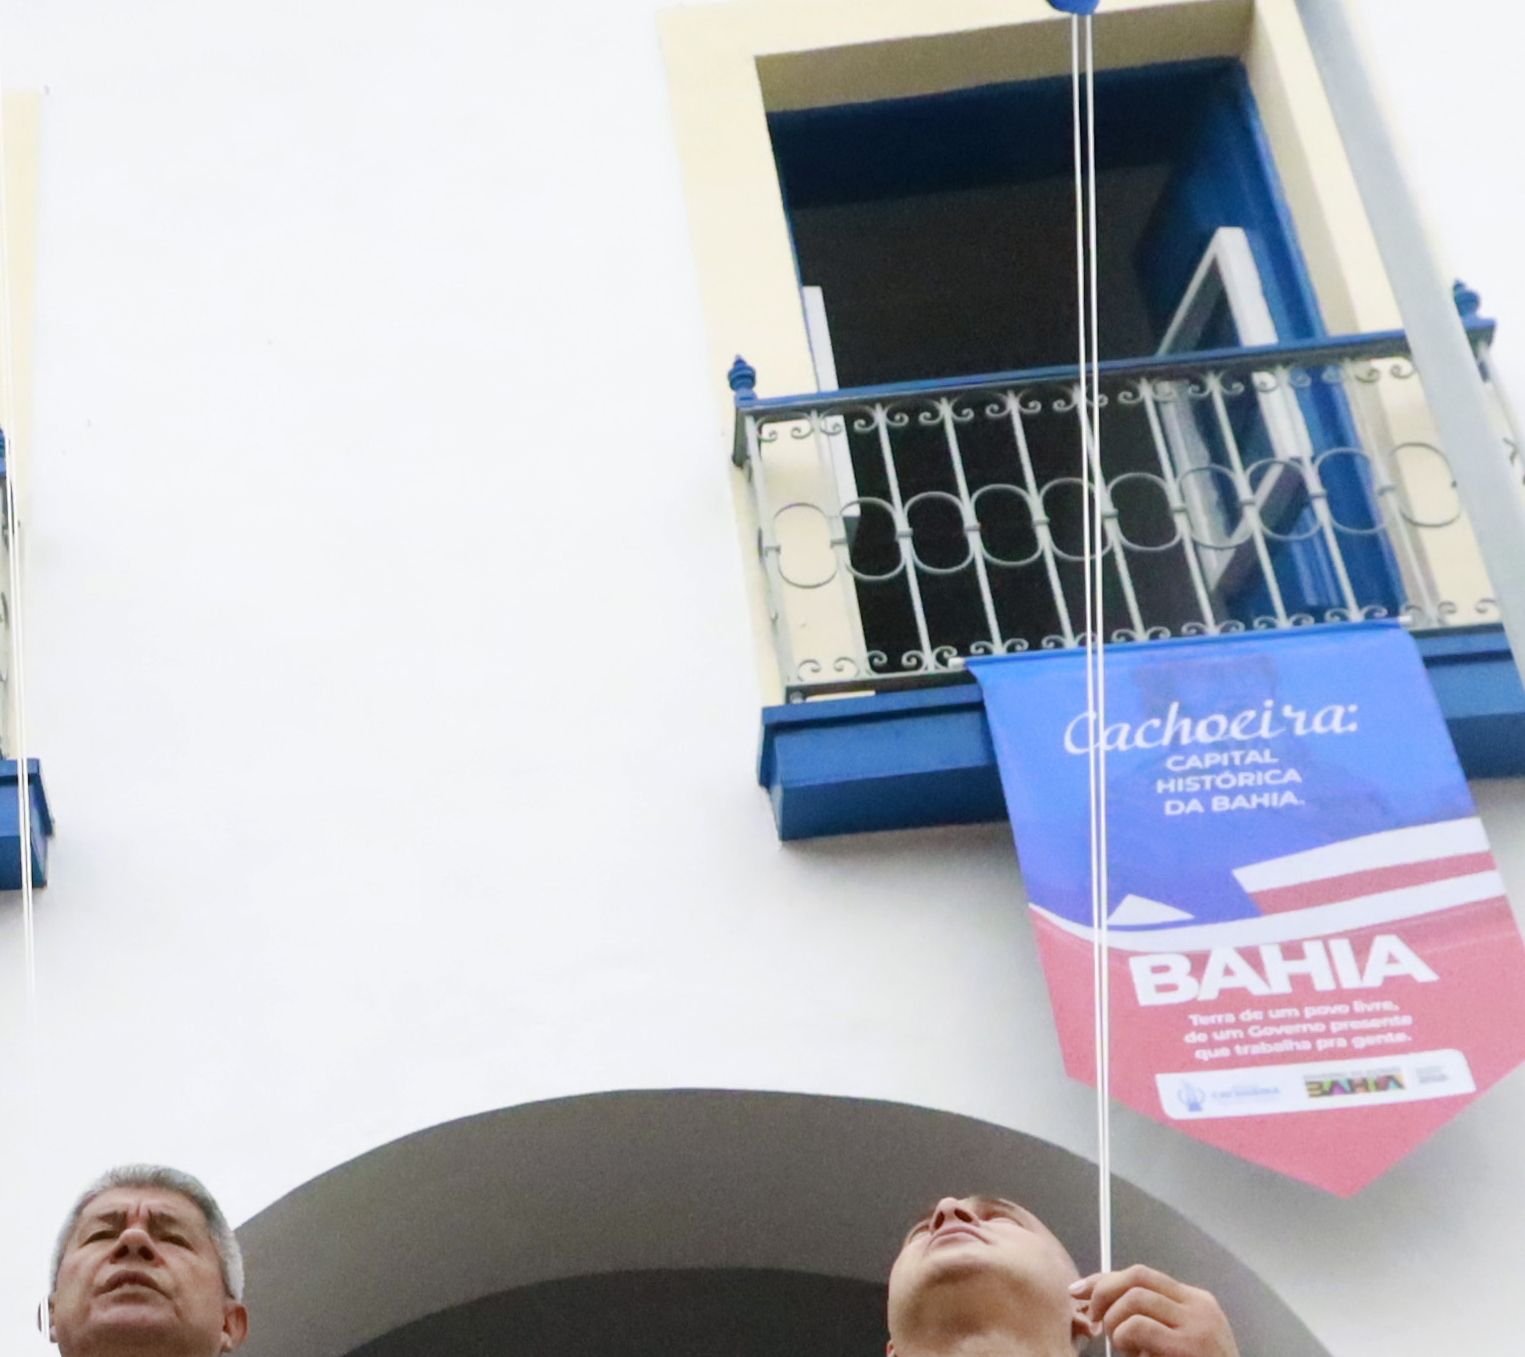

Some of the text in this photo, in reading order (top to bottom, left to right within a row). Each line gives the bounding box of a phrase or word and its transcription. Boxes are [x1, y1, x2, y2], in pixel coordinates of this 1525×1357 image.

[1063, 699, 1358, 754] Cachoeira:
[1166, 749, 1279, 771] CAPITAL
[1156, 768, 1302, 794] HISTÓRICA
[1164, 791, 1305, 816] DA BAHIA.
[1128, 934, 1440, 1007] BAHIA
[1239, 1009, 1264, 1021] de
[1269, 1008, 1300, 1019] um
[1183, 1031, 1208, 1043] de
[1212, 1029, 1244, 1041] um
[1194, 1047, 1231, 1061] que
[1316, 1037, 1347, 1051] pra
